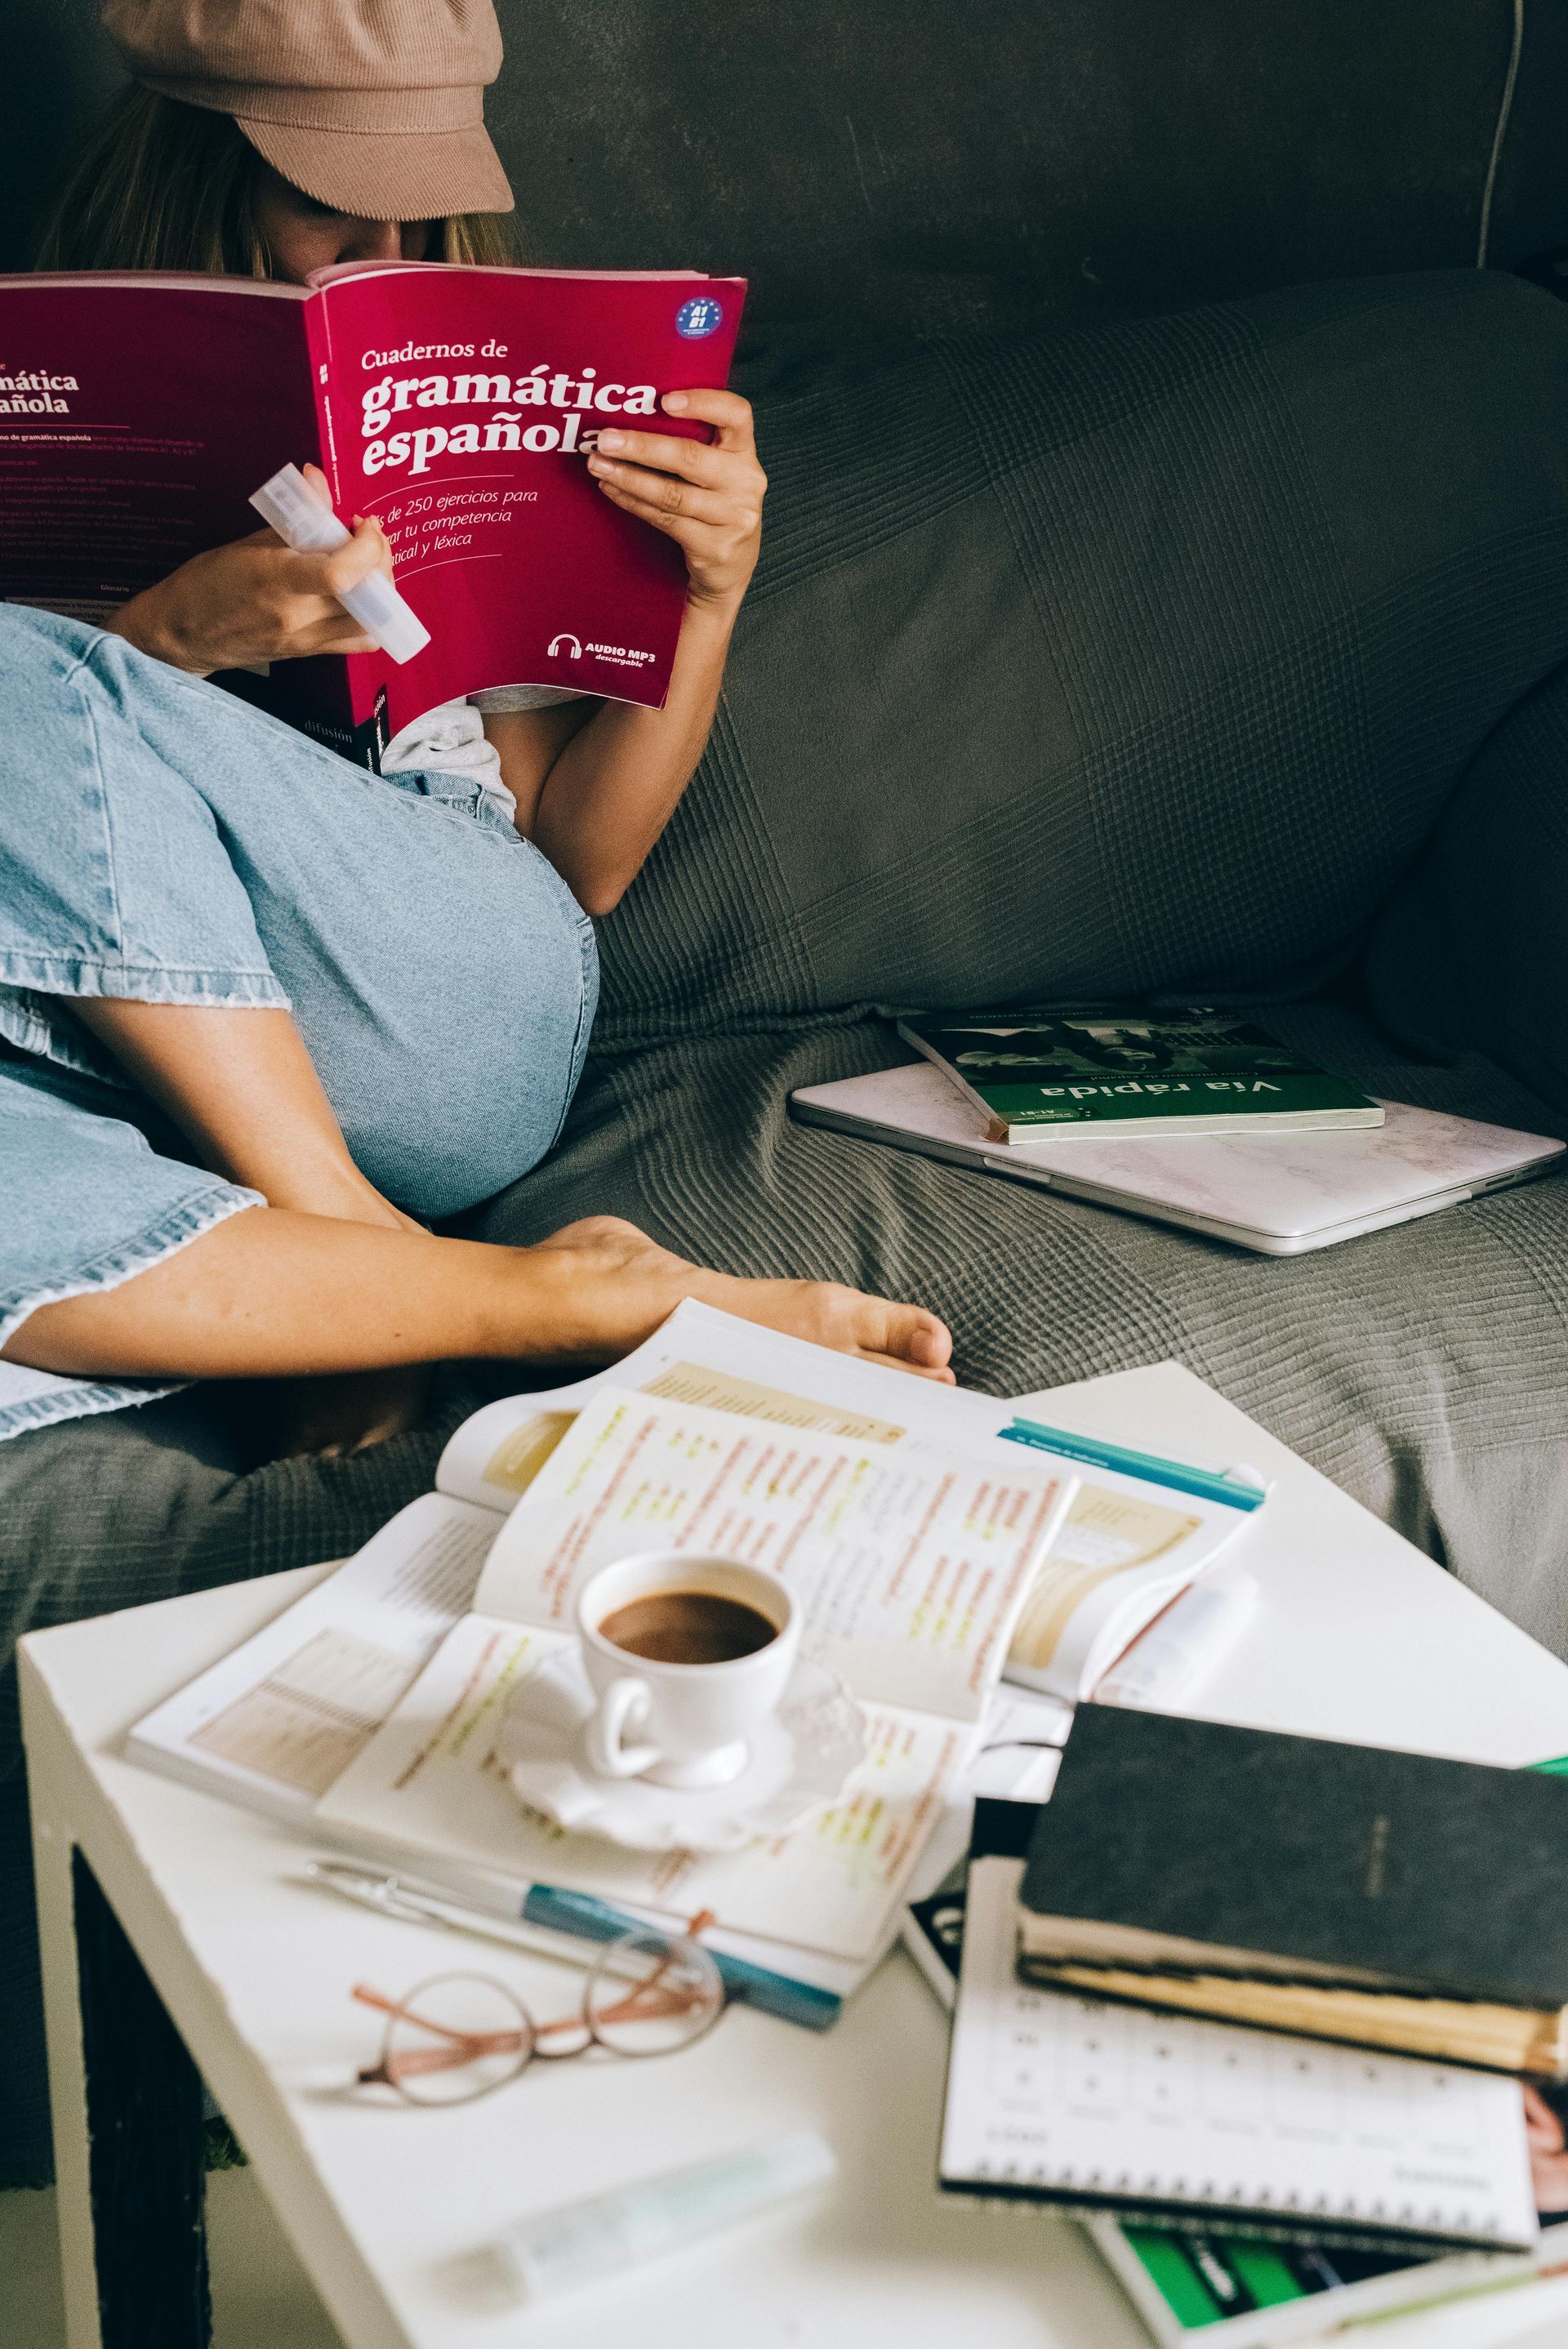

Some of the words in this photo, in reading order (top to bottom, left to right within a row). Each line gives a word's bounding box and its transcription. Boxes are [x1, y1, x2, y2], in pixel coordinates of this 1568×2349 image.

[691, 305, 709, 317] A1
[688, 317, 706, 328] B1
[361, 341, 475, 370] Cuadernos
[480, 339, 508, 359] de
[362, 364, 657, 438] gramática
[387, 506, 402, 524] de
[405, 496, 433, 516] 250
[436, 490, 498, 511] ejercicios
[502, 491, 538, 506] para
[405, 524, 418, 537] tu
[421, 509, 512, 533] competencia
[421, 542, 430, 559] y
[434, 533, 472, 550] léxica
[99, 583, 131, 593] Glosario
[585, 643, 626, 657] AUDIO
[627, 649, 656, 663] MP3
[595, 653, 644, 668] descargable
[305, 720, 353, 743] difusión
[1040, 1081, 1191, 1099] rápida
[1205, 1081, 1282, 1093] Vía
